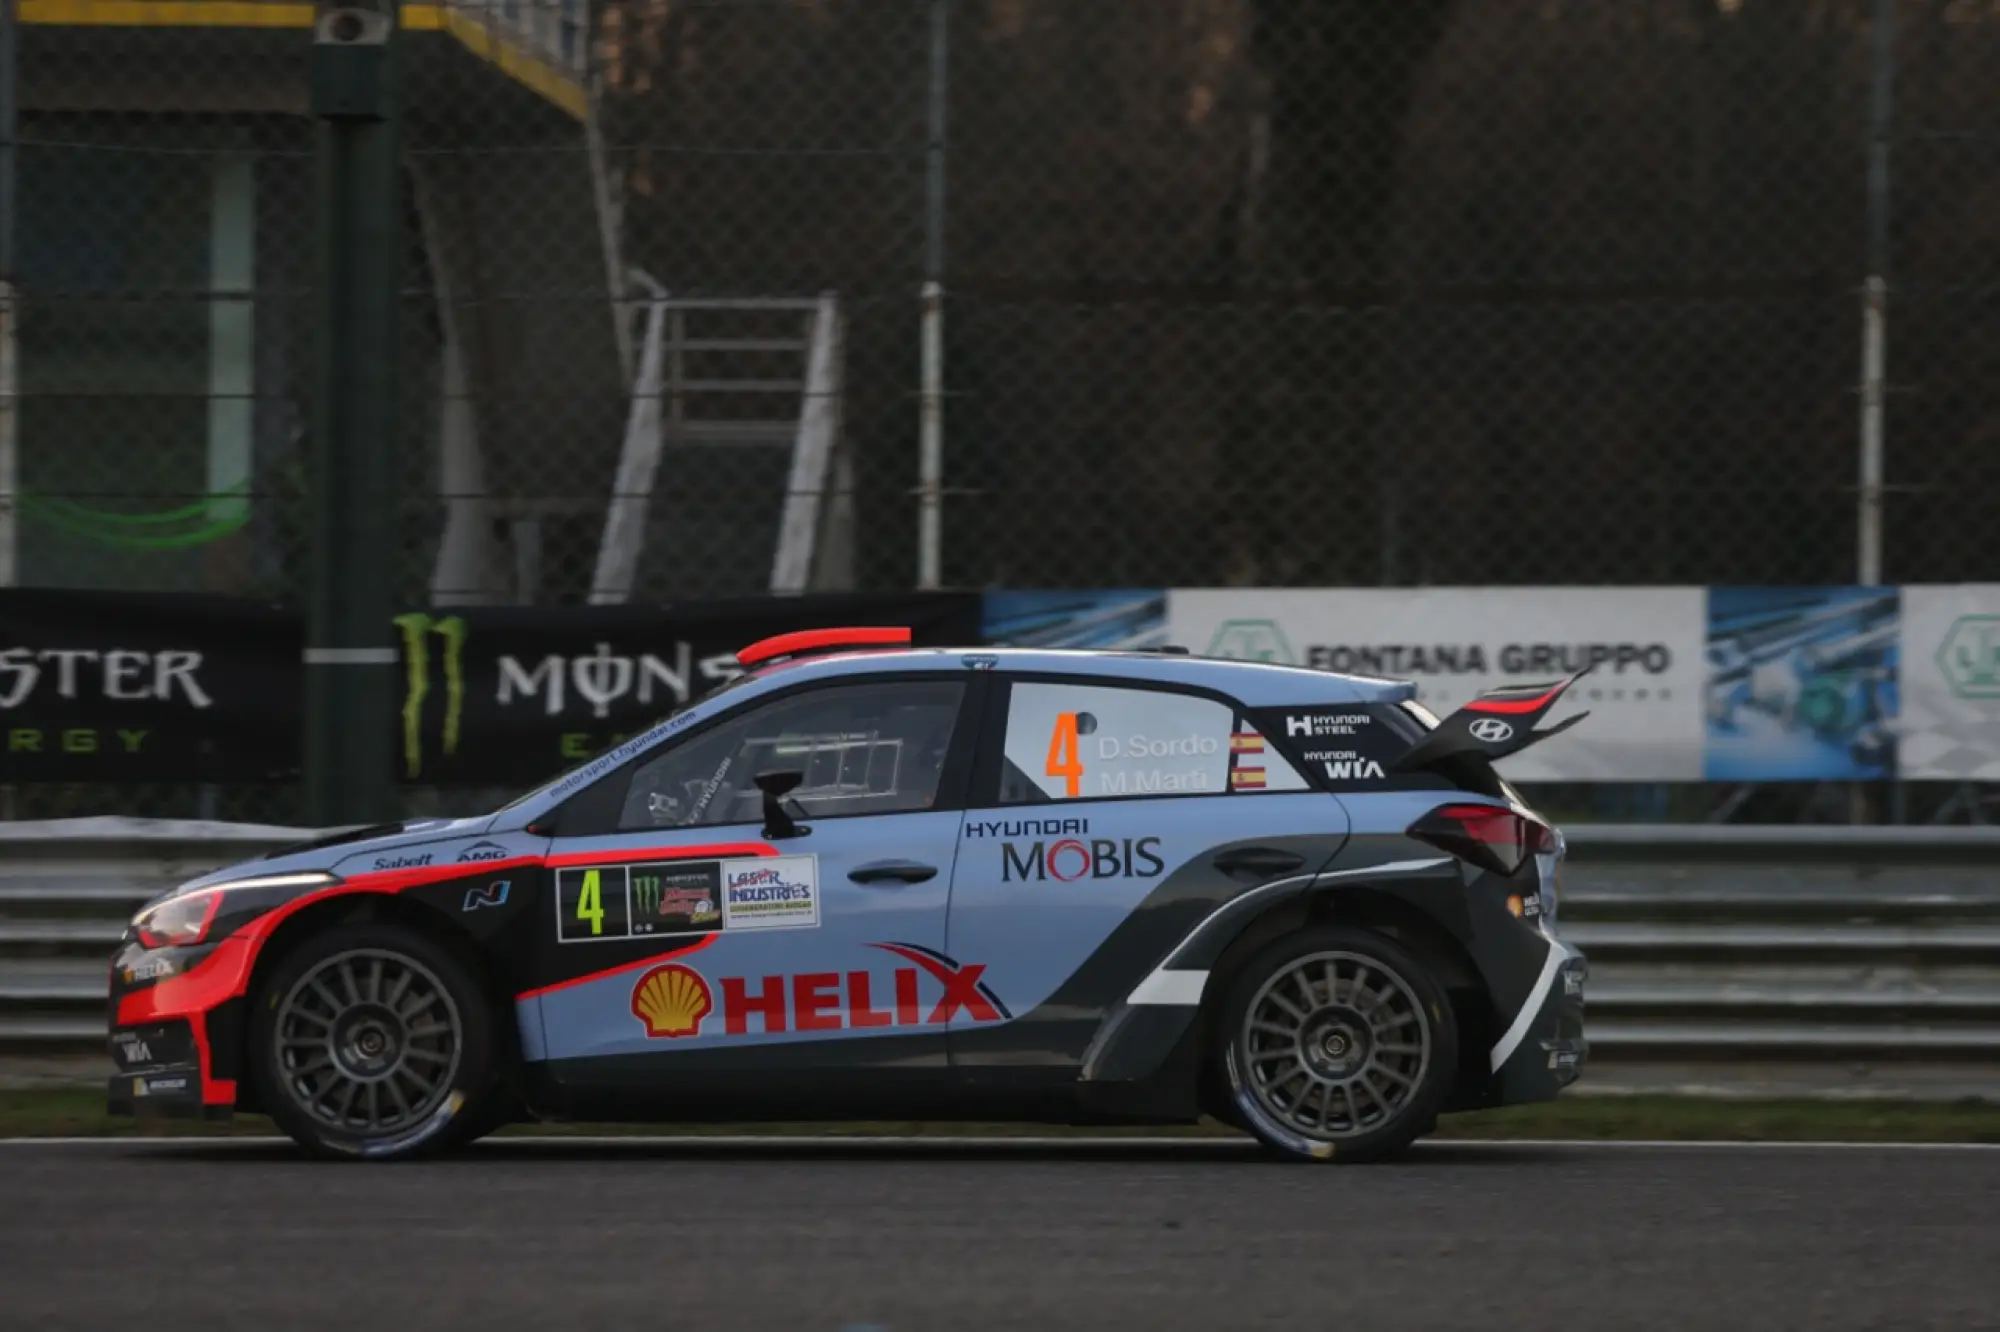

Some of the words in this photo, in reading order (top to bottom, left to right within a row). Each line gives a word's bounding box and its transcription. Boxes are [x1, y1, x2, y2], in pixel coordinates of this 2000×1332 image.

[1306, 643, 1488, 675] FONTANA
[1500, 642, 1672, 675] GRUPPO
[1313, 715, 1370, 725] HYUNDAI
[1314, 726, 1357, 735] STEEL
[550, 710, 697, 798] motorsport.hyundai.com
[1045, 712, 1083, 797] 4
[1100, 734, 1218, 760] D.Sordo
[1304, 751, 1357, 761] HYUNDAI
[966, 818, 1089, 837] HYUNDAI
[1001, 836, 1165, 882] MOBIS
[576, 869, 605, 935] 4
[719, 958, 1003, 1036] HELIX
